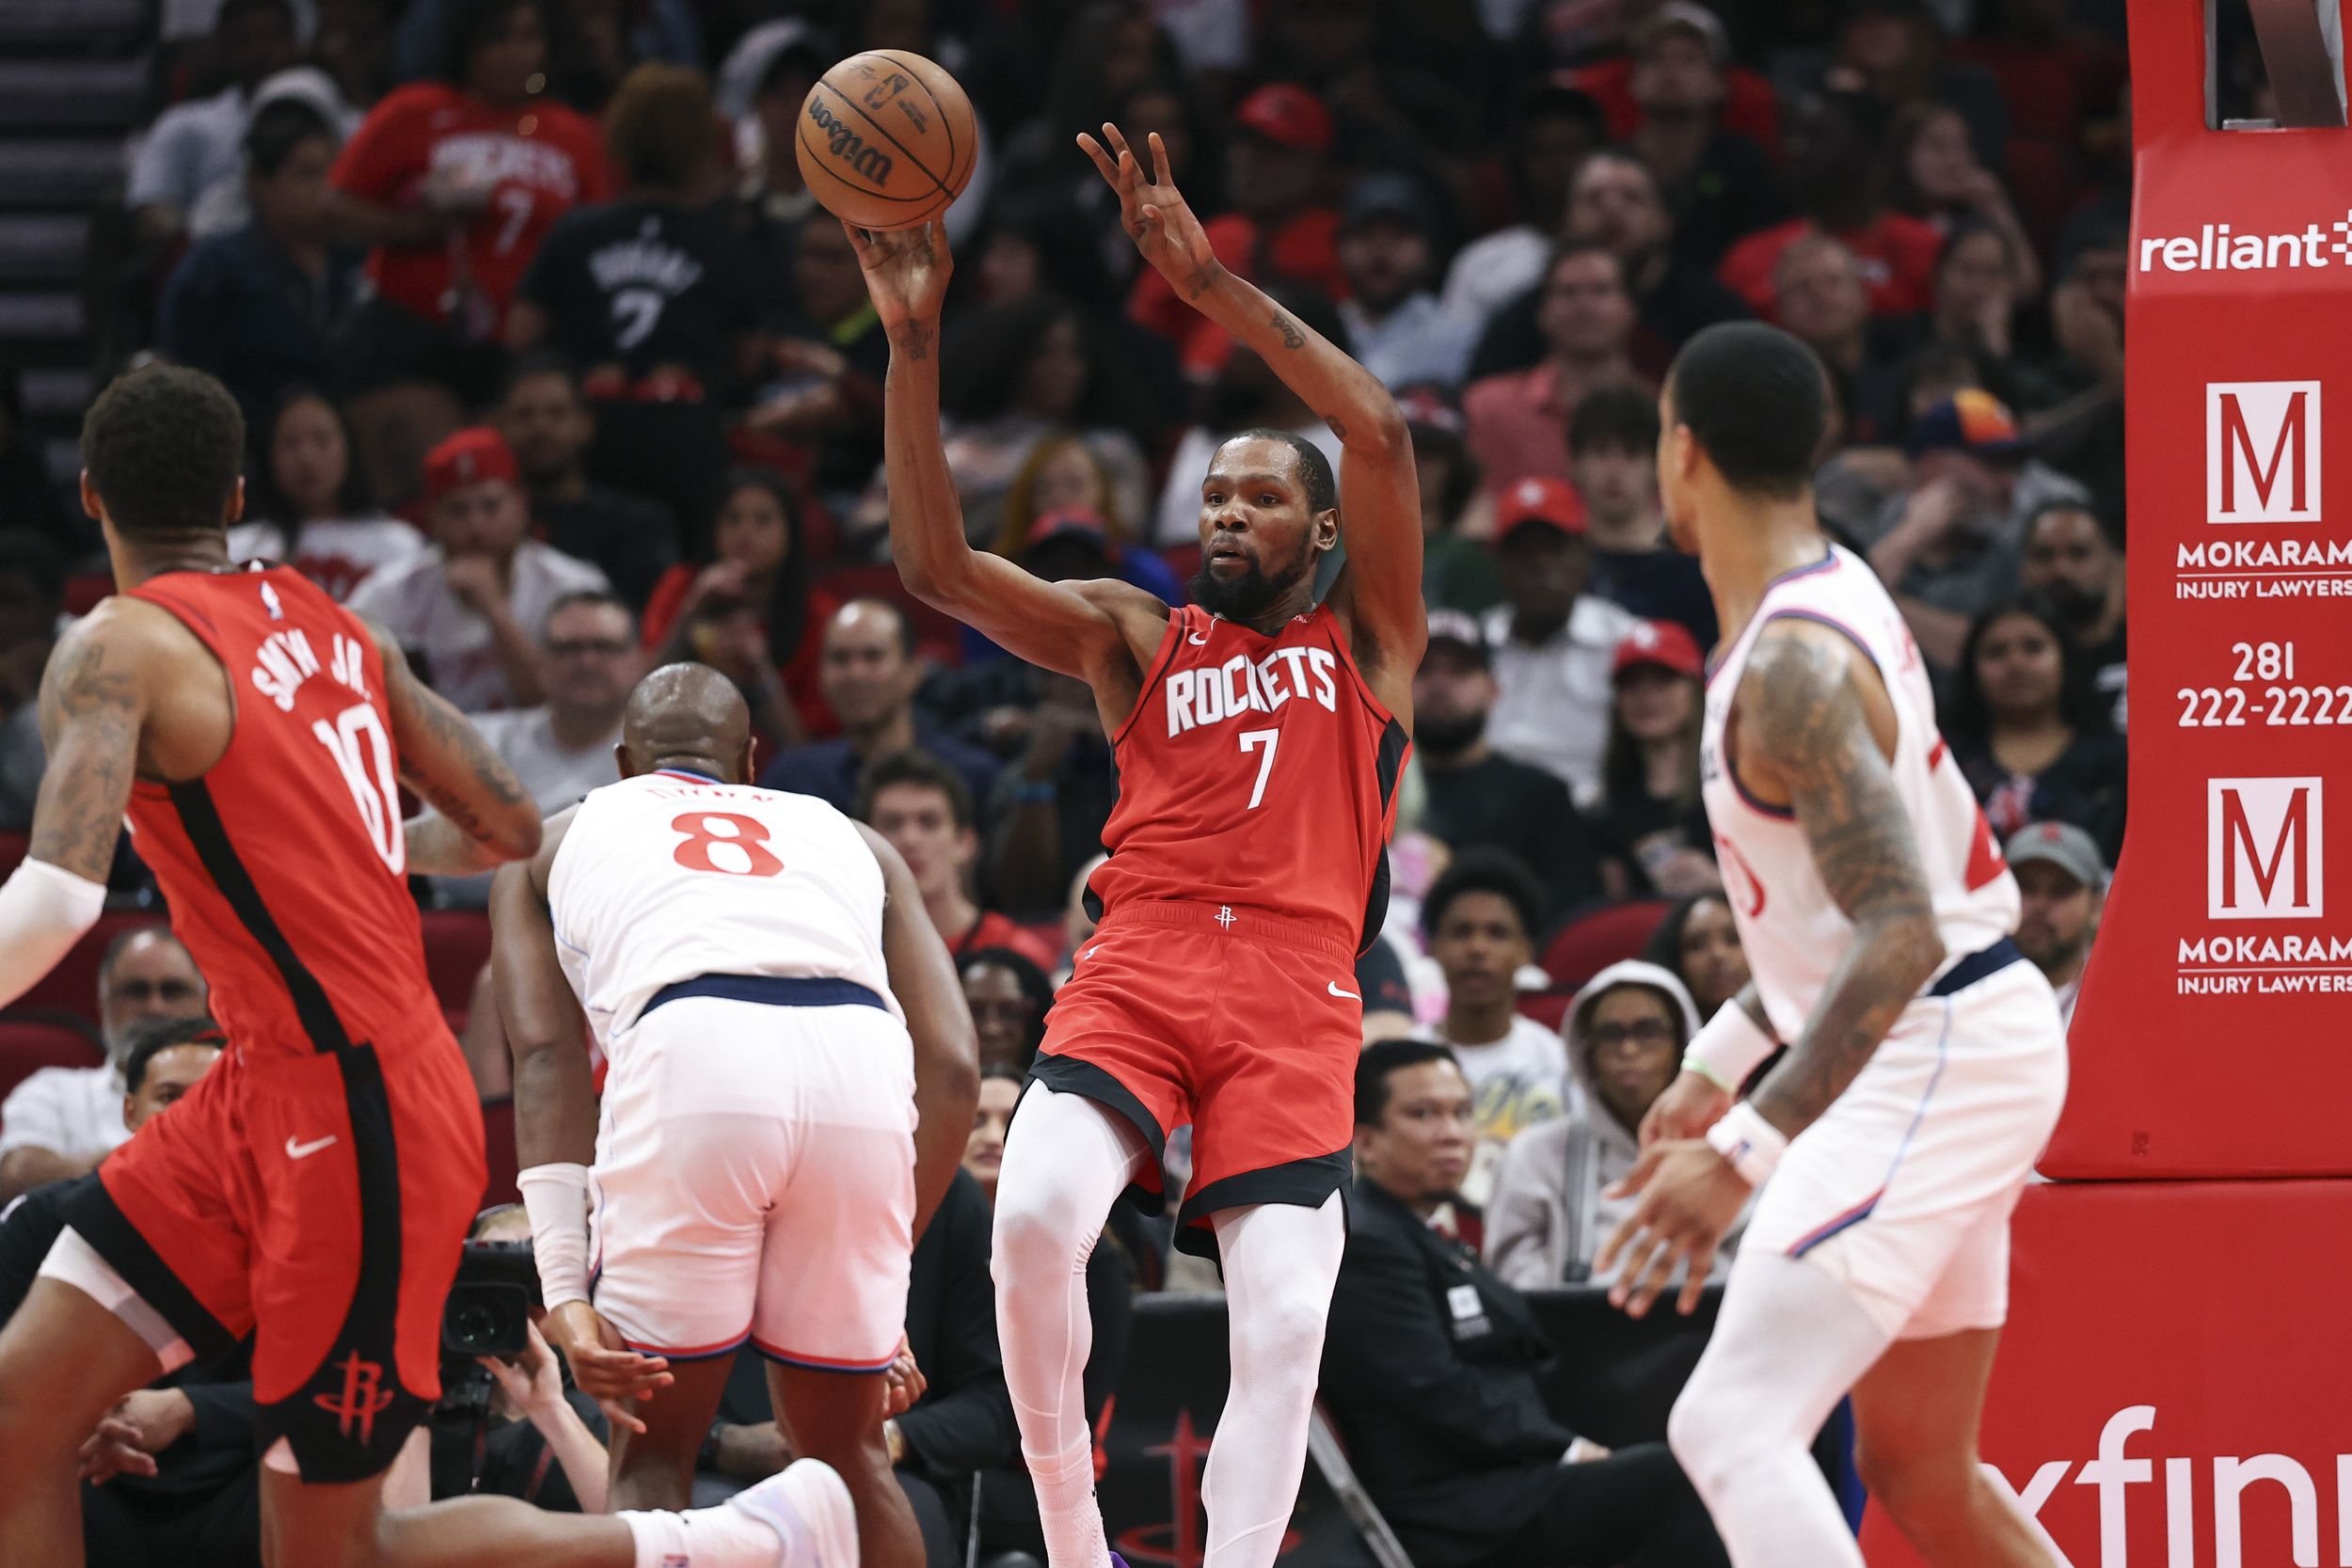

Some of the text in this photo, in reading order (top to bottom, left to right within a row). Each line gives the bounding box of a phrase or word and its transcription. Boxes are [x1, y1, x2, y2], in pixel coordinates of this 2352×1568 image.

[808, 94, 893, 188] Wilson
[2139, 224, 2329, 272] reliant
[613, 288, 663, 350] 7
[2220, 391, 2308, 513] M
[2176, 539, 2352, 568] MOKARAM
[2176, 580, 2250, 599] INJURY
[2232, 641, 2294, 681] 281
[1166, 646, 1337, 739] ROCKETS
[2177, 686, 2352, 727] 222-2222
[311, 703, 406, 876] 10
[1238, 728, 1279, 810] 7
[671, 812, 785, 877] 8
[2220, 787, 2310, 908] M
[2177, 935, 2352, 963] MOKARAM
[2177, 976, 2252, 994] INJURY
